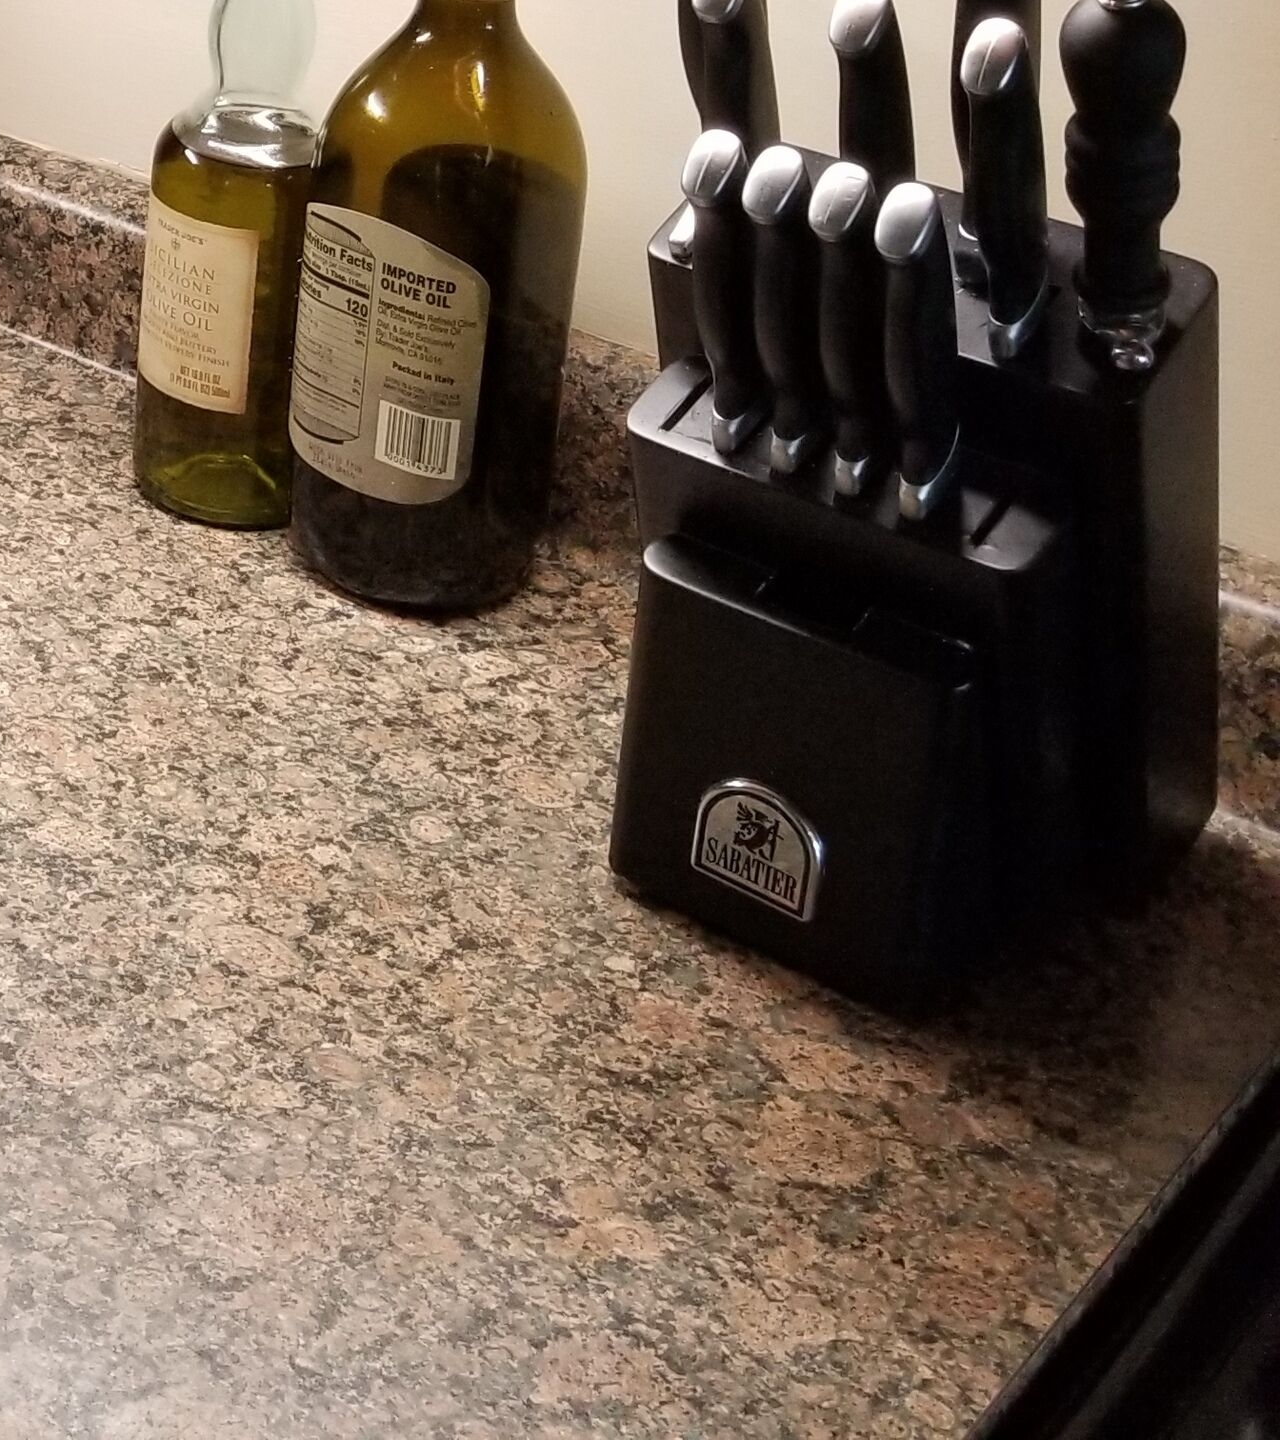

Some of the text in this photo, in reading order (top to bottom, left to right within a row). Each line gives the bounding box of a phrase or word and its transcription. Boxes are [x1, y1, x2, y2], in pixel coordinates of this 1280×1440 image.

[153, 244, 215, 281] ICILIAN
[306, 231, 336, 258] utrition
[339, 247, 373, 273] Facts
[380, 277, 452, 310] OLIVE OIL
[382, 262, 457, 295] IMPORTED
[171, 289, 219, 314] VIRGIN
[345, 296, 369, 319] 120
[183, 311, 214, 332] OIL
[391, 360, 455, 387] Packed in Italy
[705, 836, 798, 904] SABATIER
